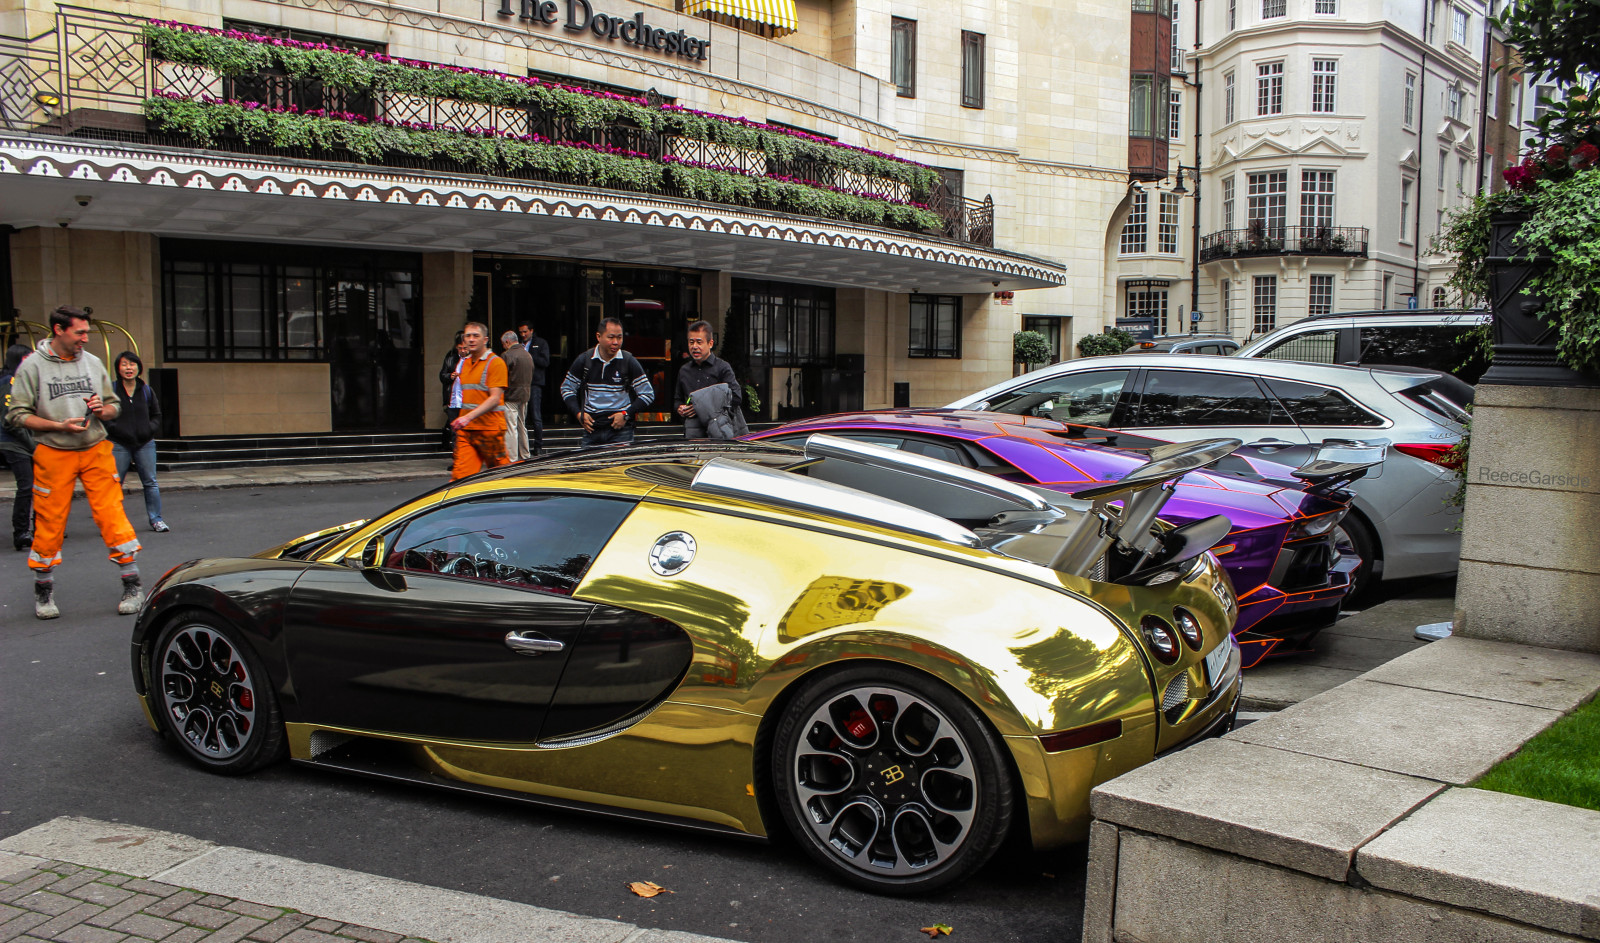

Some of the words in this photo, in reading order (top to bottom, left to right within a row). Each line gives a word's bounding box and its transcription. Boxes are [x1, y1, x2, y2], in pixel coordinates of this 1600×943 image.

[564, 0, 711, 61] Dorchester
[47, 378, 94, 401] LONSDALE
[853, 723, 866, 736] ATTI
